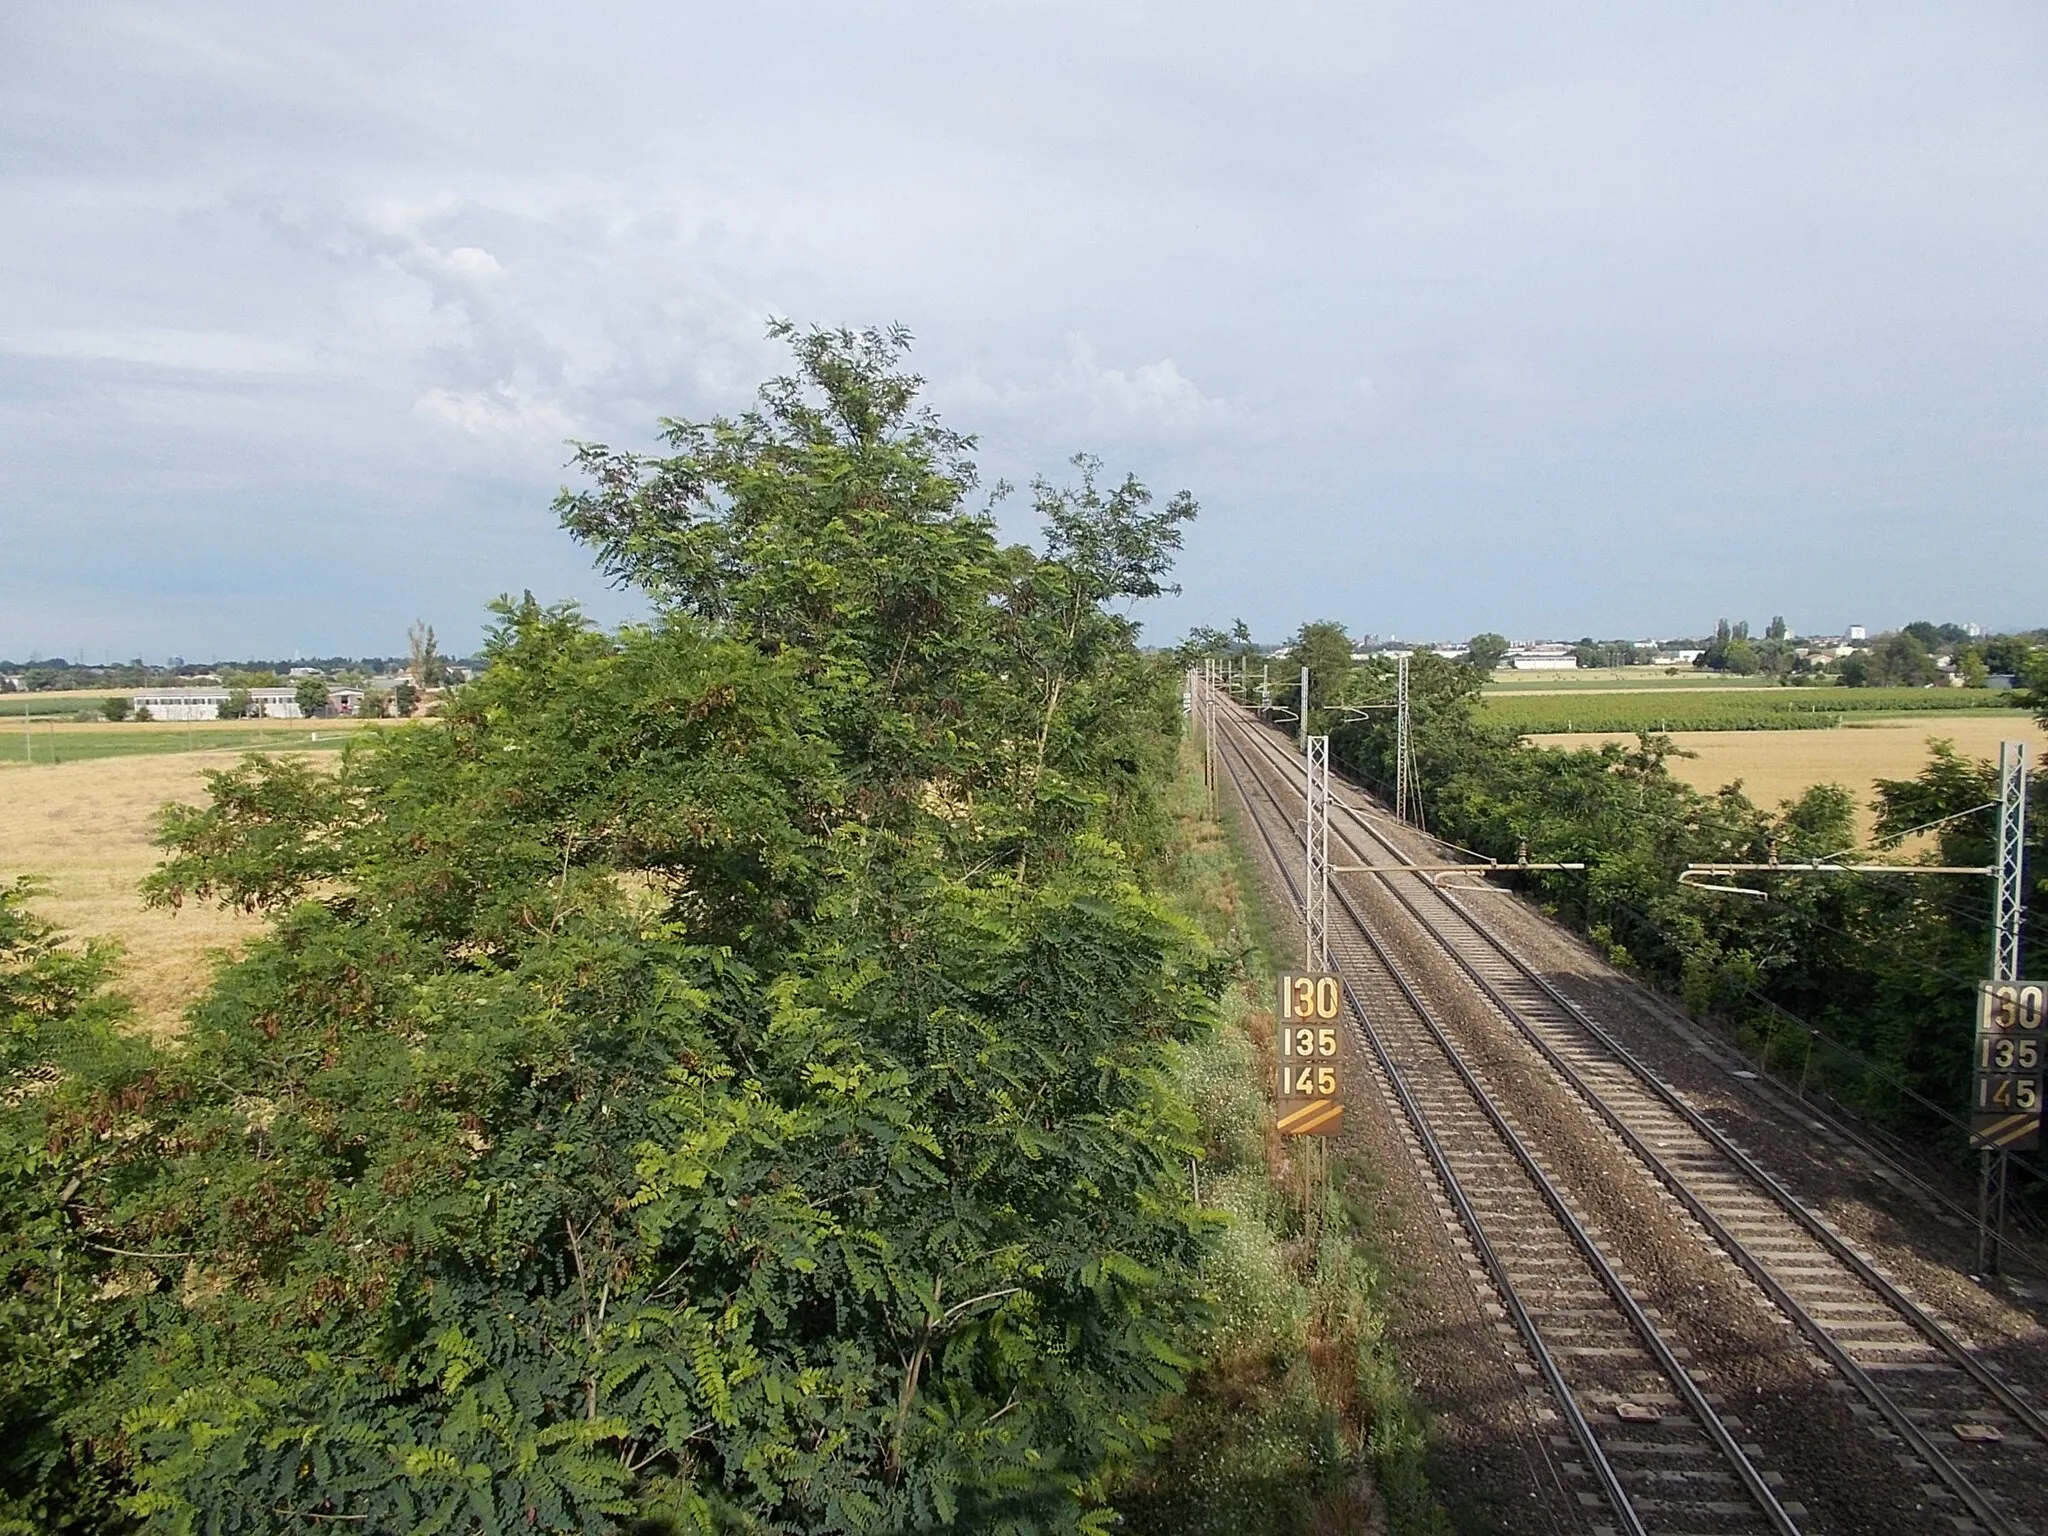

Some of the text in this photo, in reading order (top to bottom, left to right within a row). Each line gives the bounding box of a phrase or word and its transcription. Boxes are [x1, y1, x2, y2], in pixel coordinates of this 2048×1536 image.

[1284, 976, 1338, 1019] 130
[1983, 985, 2042, 1029] 130
[1284, 1028, 1336, 1056] 135
[1981, 1039, 2038, 1068] 135
[1284, 1067, 1336, 1095] 145
[1980, 1078, 2036, 1108] 145
